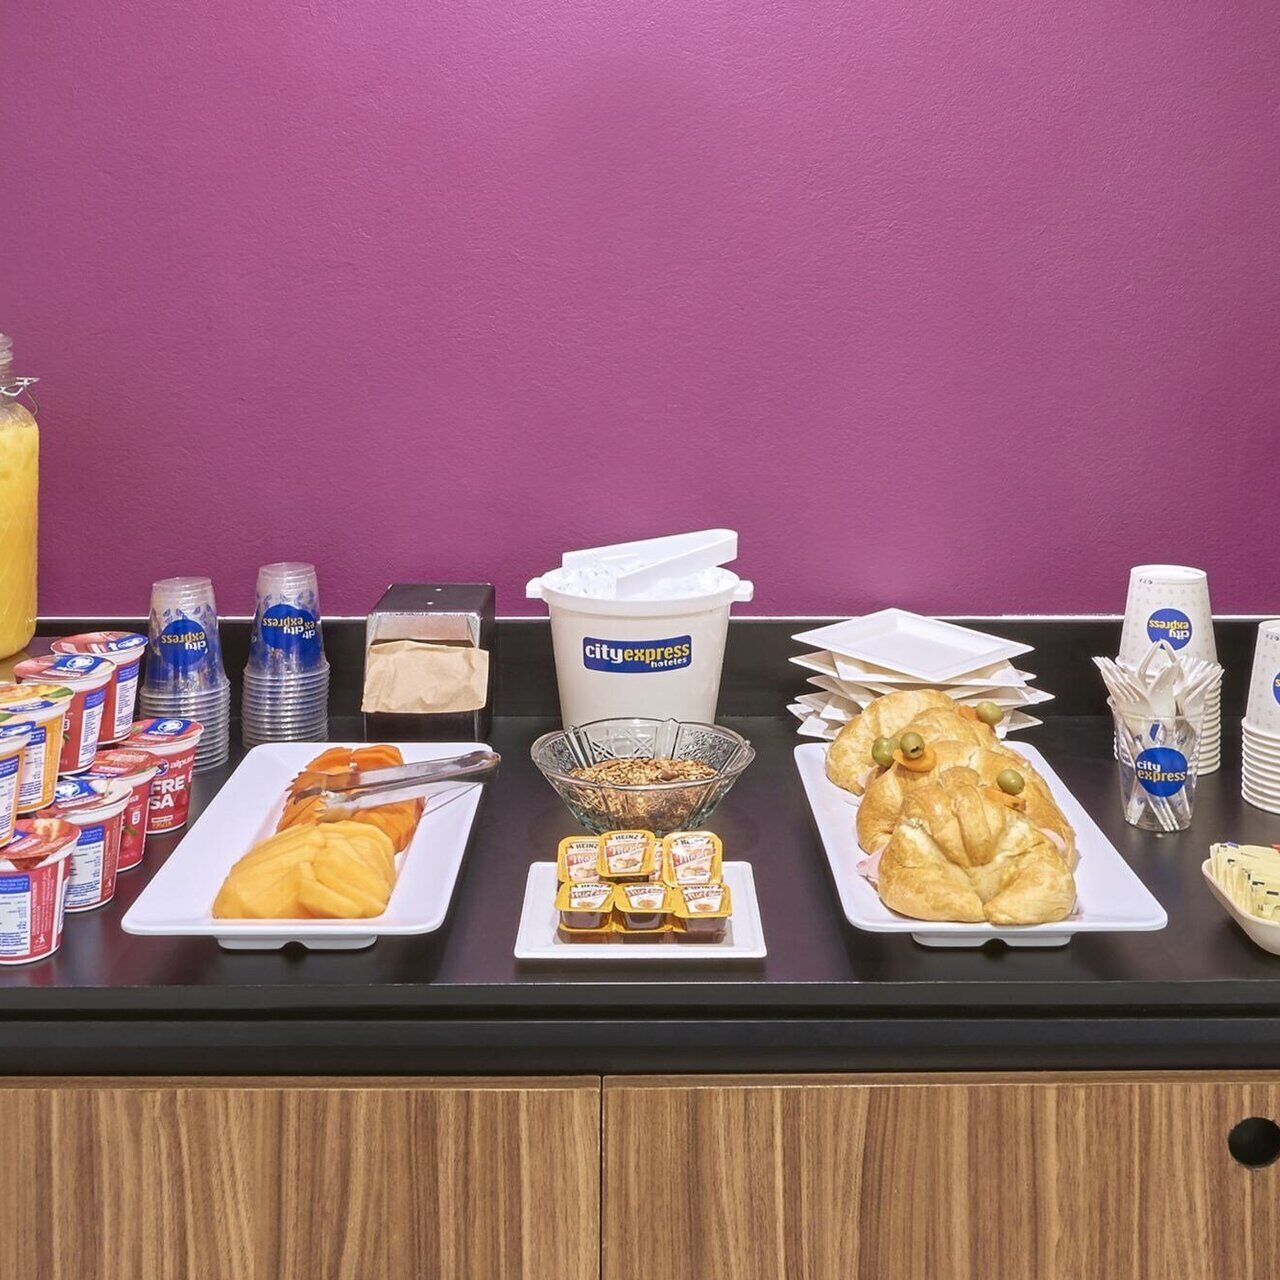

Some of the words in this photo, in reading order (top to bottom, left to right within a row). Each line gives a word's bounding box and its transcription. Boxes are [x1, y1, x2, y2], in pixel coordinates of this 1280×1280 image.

[262, 617, 304, 628] express
[1149, 619, 1189, 630] express
[284, 625, 305, 636] city
[1169, 629, 1189, 640] city
[161, 631, 206, 645] express
[185, 639, 207, 651] city
[651, 656, 688, 668] hoteles
[1136, 760, 1161, 772] city
[1137, 769, 1186, 783] express
[150, 774, 186, 795] FRE
[615, 833, 640, 841] HEINZ
